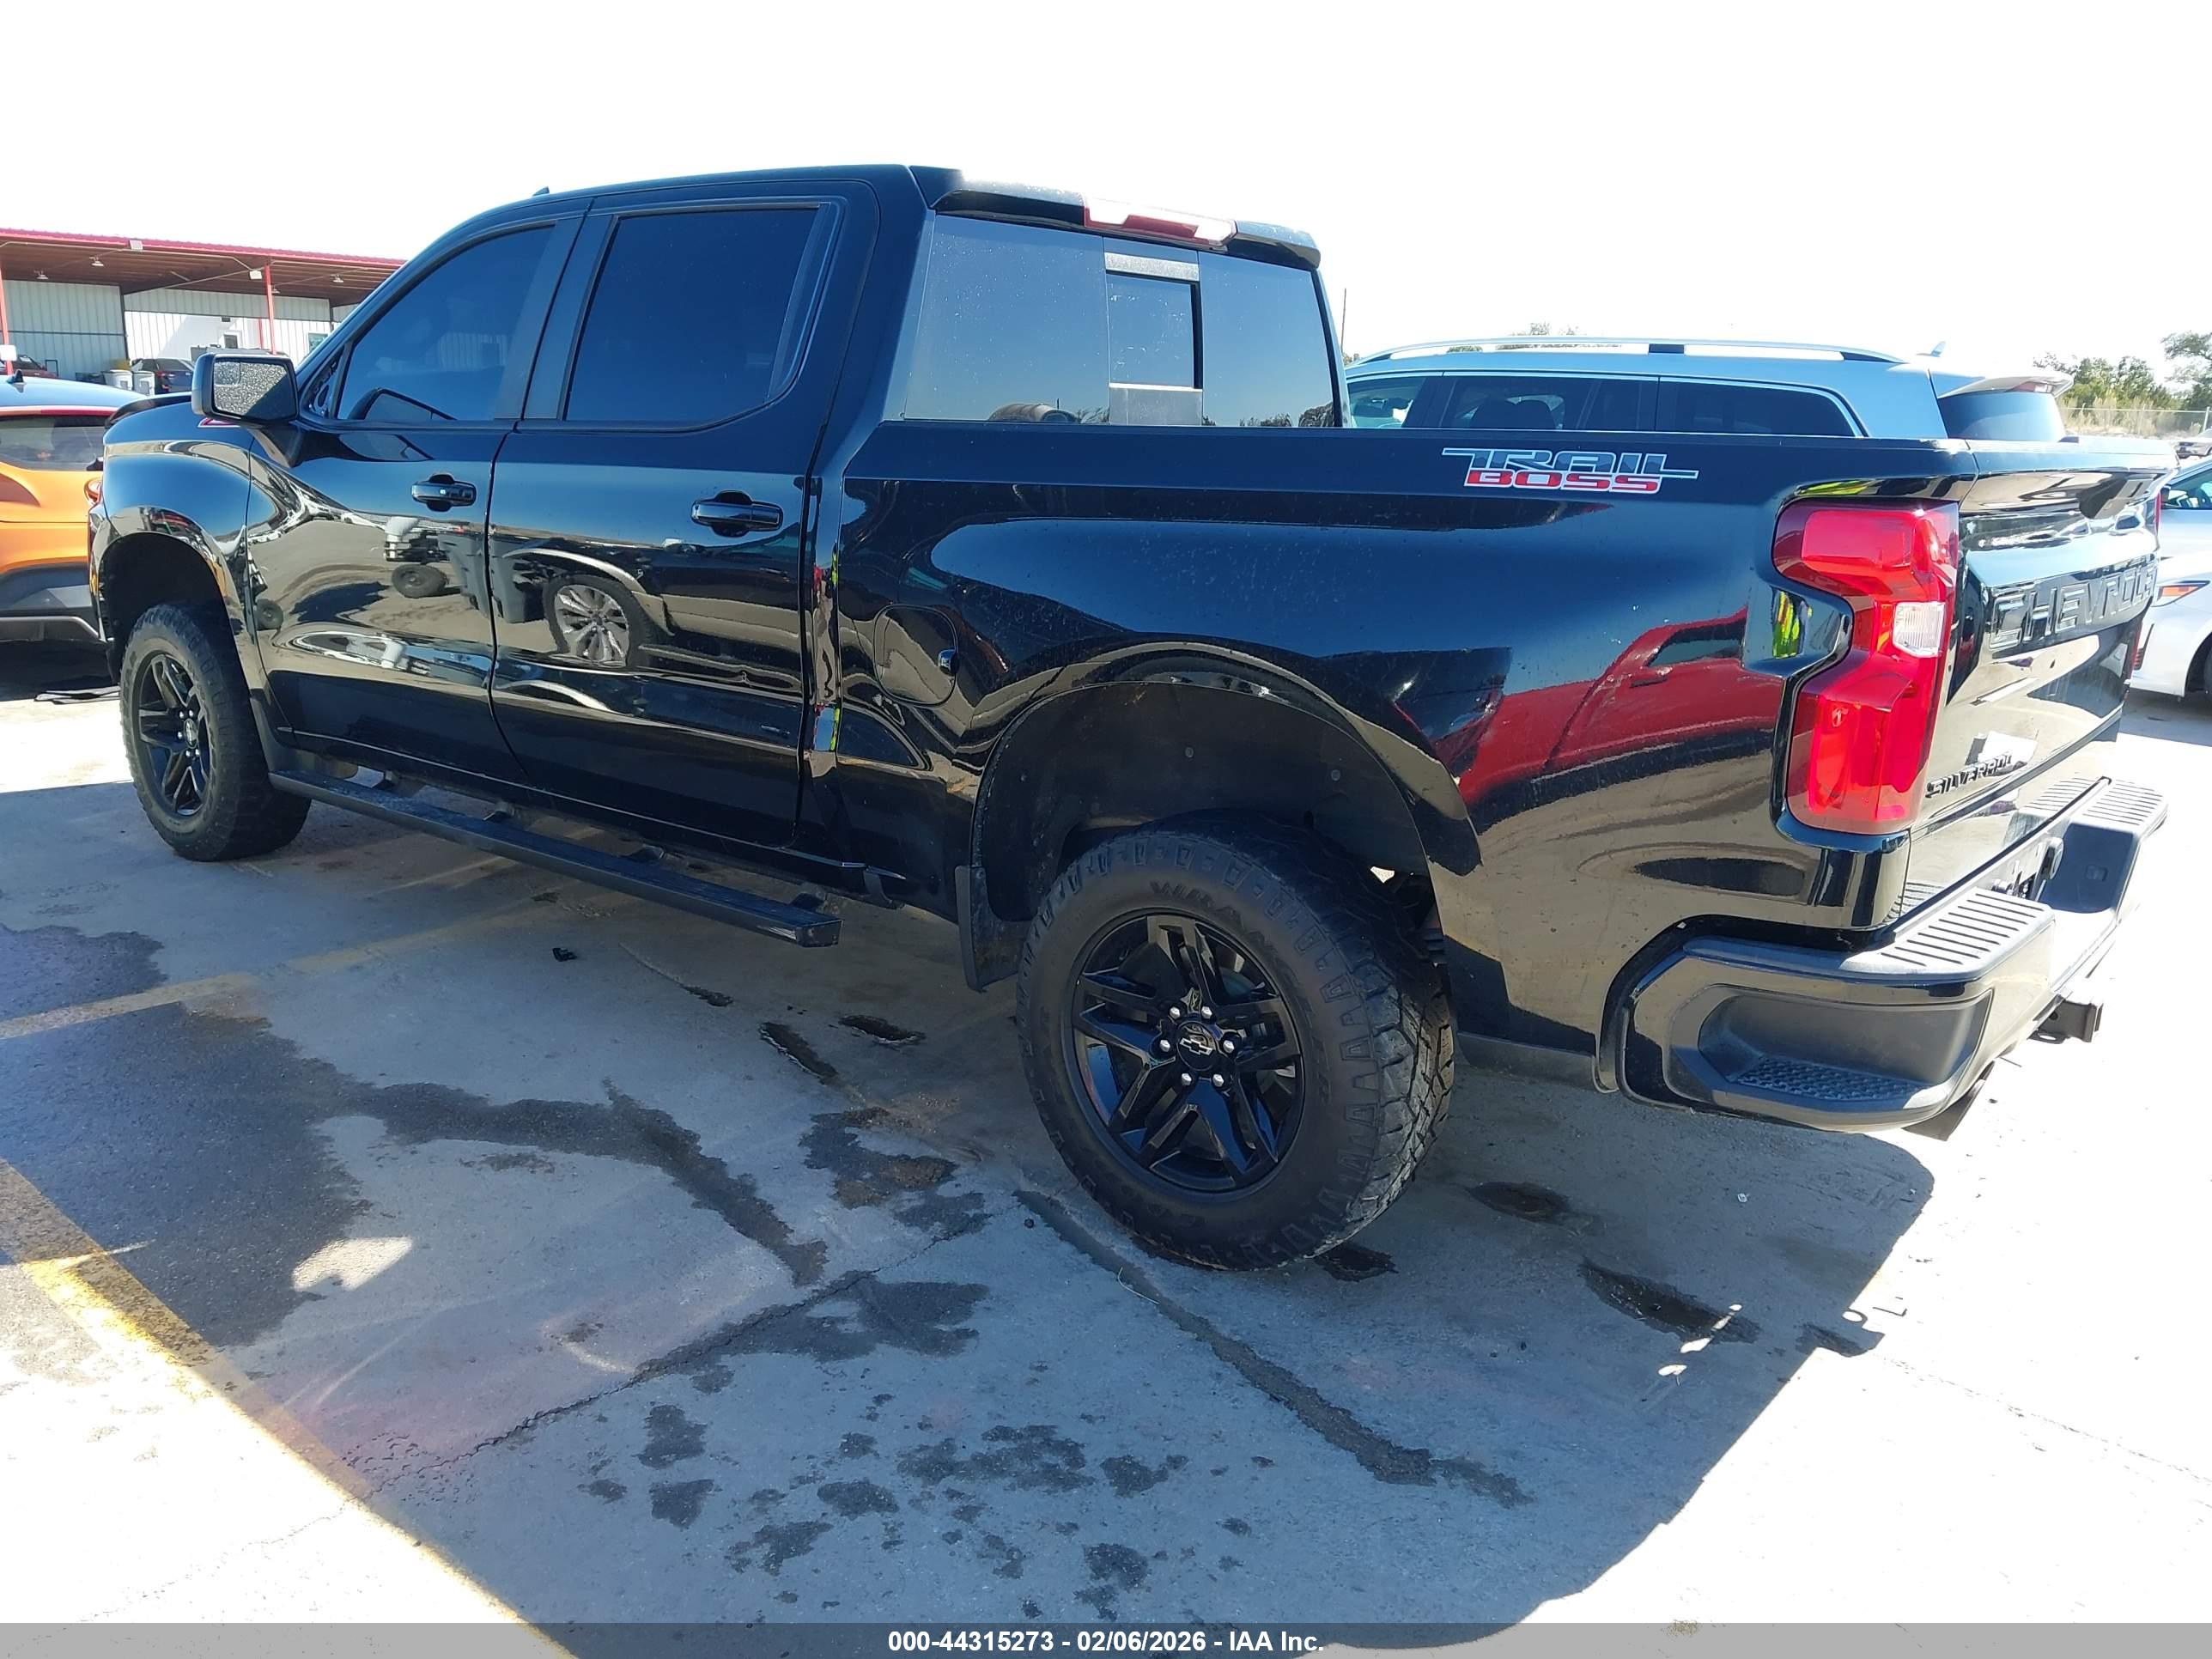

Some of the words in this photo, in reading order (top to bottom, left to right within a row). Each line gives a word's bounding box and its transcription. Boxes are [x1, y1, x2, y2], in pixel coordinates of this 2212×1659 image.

[1442, 447, 1699, 479] TRAIL
[1463, 470, 1663, 495] BOSS
[1988, 566, 2157, 650] CHEVROLE
